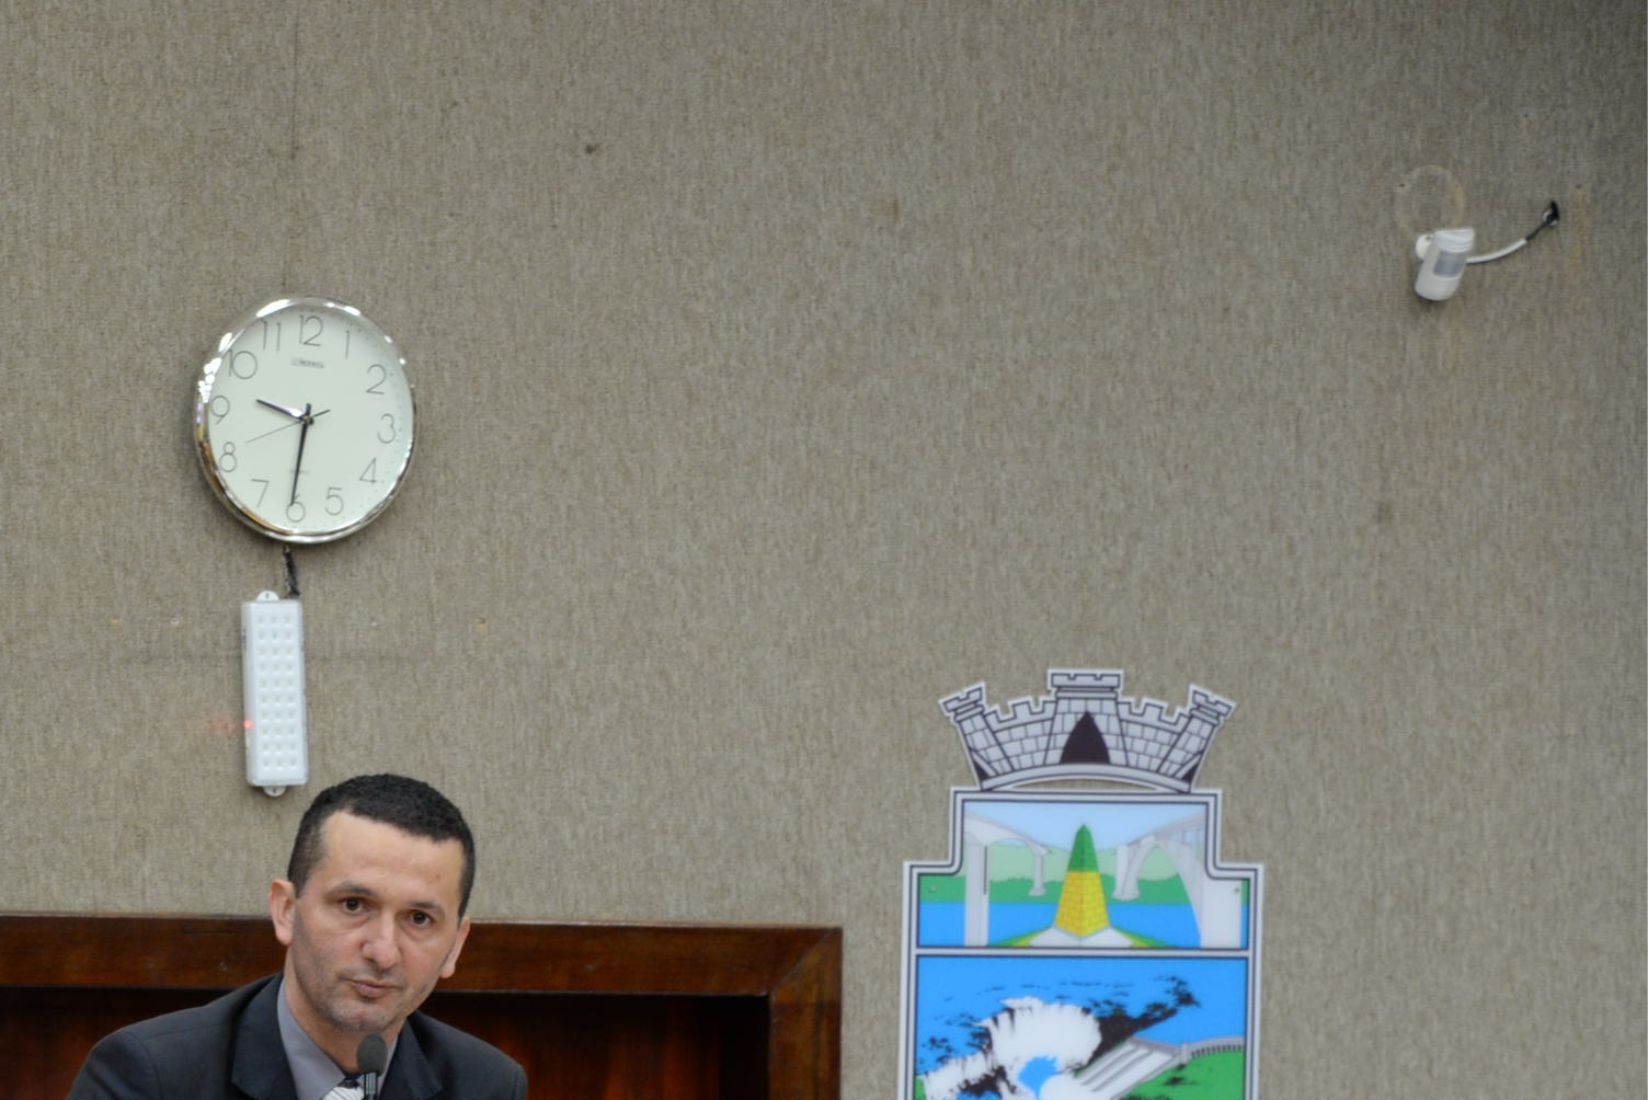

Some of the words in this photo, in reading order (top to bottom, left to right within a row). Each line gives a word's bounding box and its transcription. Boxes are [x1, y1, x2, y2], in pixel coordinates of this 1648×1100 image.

[261, 319, 281, 352] 11
[299, 315, 324, 347] 12
[344, 330, 351, 359] 1
[228, 349, 258, 380] 10
[365, 364, 387, 395] 2
[210, 395, 230, 425] 9
[377, 413, 397, 444] 3
[219, 441, 237, 473] 8
[359, 457, 378, 484] 4
[250, 478, 270, 508] 7
[325, 486, 345, 516] 5
[285, 494, 306, 523] 6
